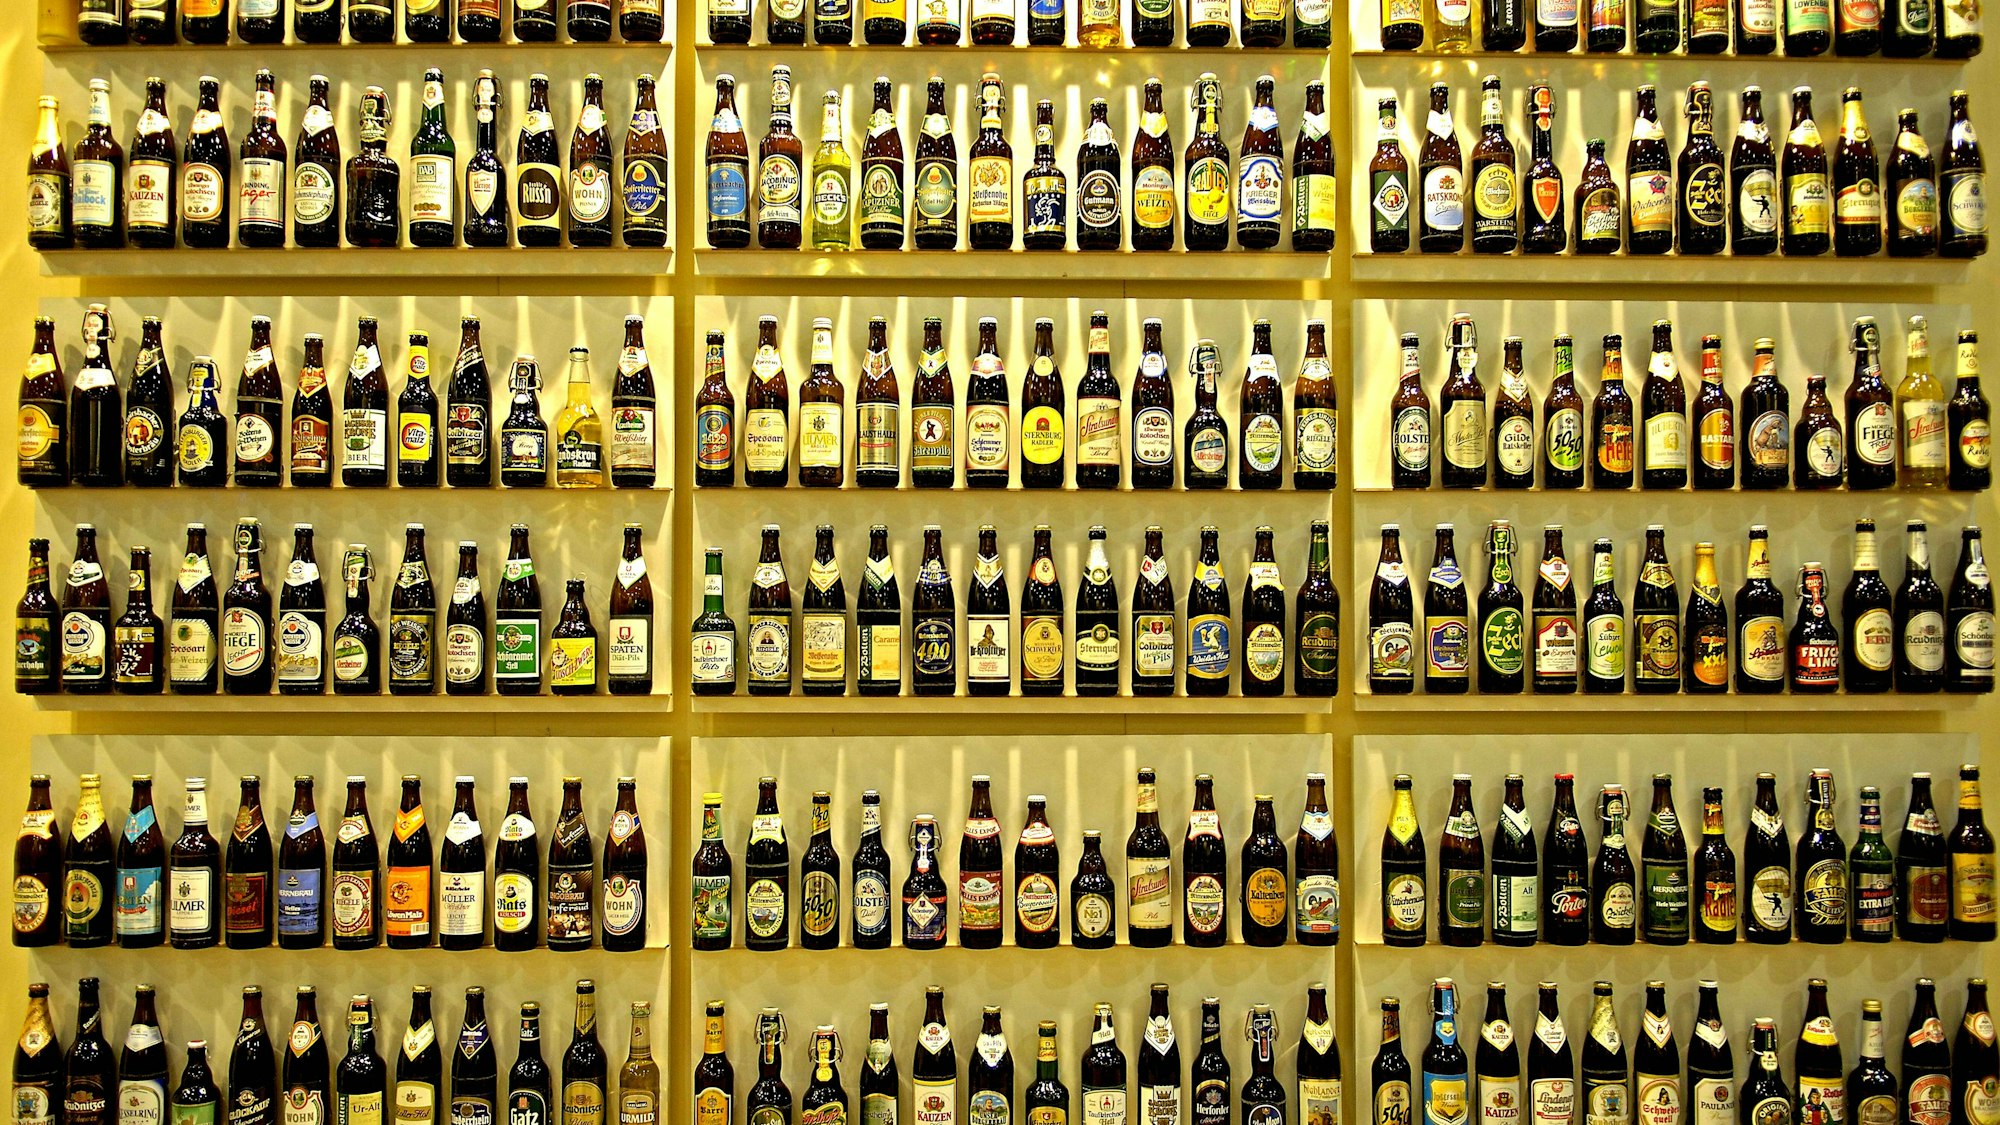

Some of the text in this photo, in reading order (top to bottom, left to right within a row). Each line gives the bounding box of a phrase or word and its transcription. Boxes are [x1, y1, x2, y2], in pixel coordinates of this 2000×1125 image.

[129, 190, 164, 202] KAUZEN
[575, 190, 602, 199] WOHN
[1024, 431, 1062, 440] STERNBURG
[1504, 434, 1530, 442] Gilde
[1598, 632, 1620, 641] Lübzer
[610, 645, 644, 654] SPATEN
[695, 878, 726, 887] ULMER
[1523, 887, 1533, 895] Alt
[497, 899, 526, 910] Rats
[606, 900, 633, 911] WOHN
[1859, 898, 1878, 909] EXTRA
[353, 1103, 380, 1113] Ur-Alt
[1196, 1103, 1229, 1115] Herforder
[1485, 1106, 1519, 1117] KAUZEN
[287, 1112, 314, 1122] WOHN
[510, 1108, 538, 1125] Gatz
[918, 1111, 952, 1122] KAUZEN
